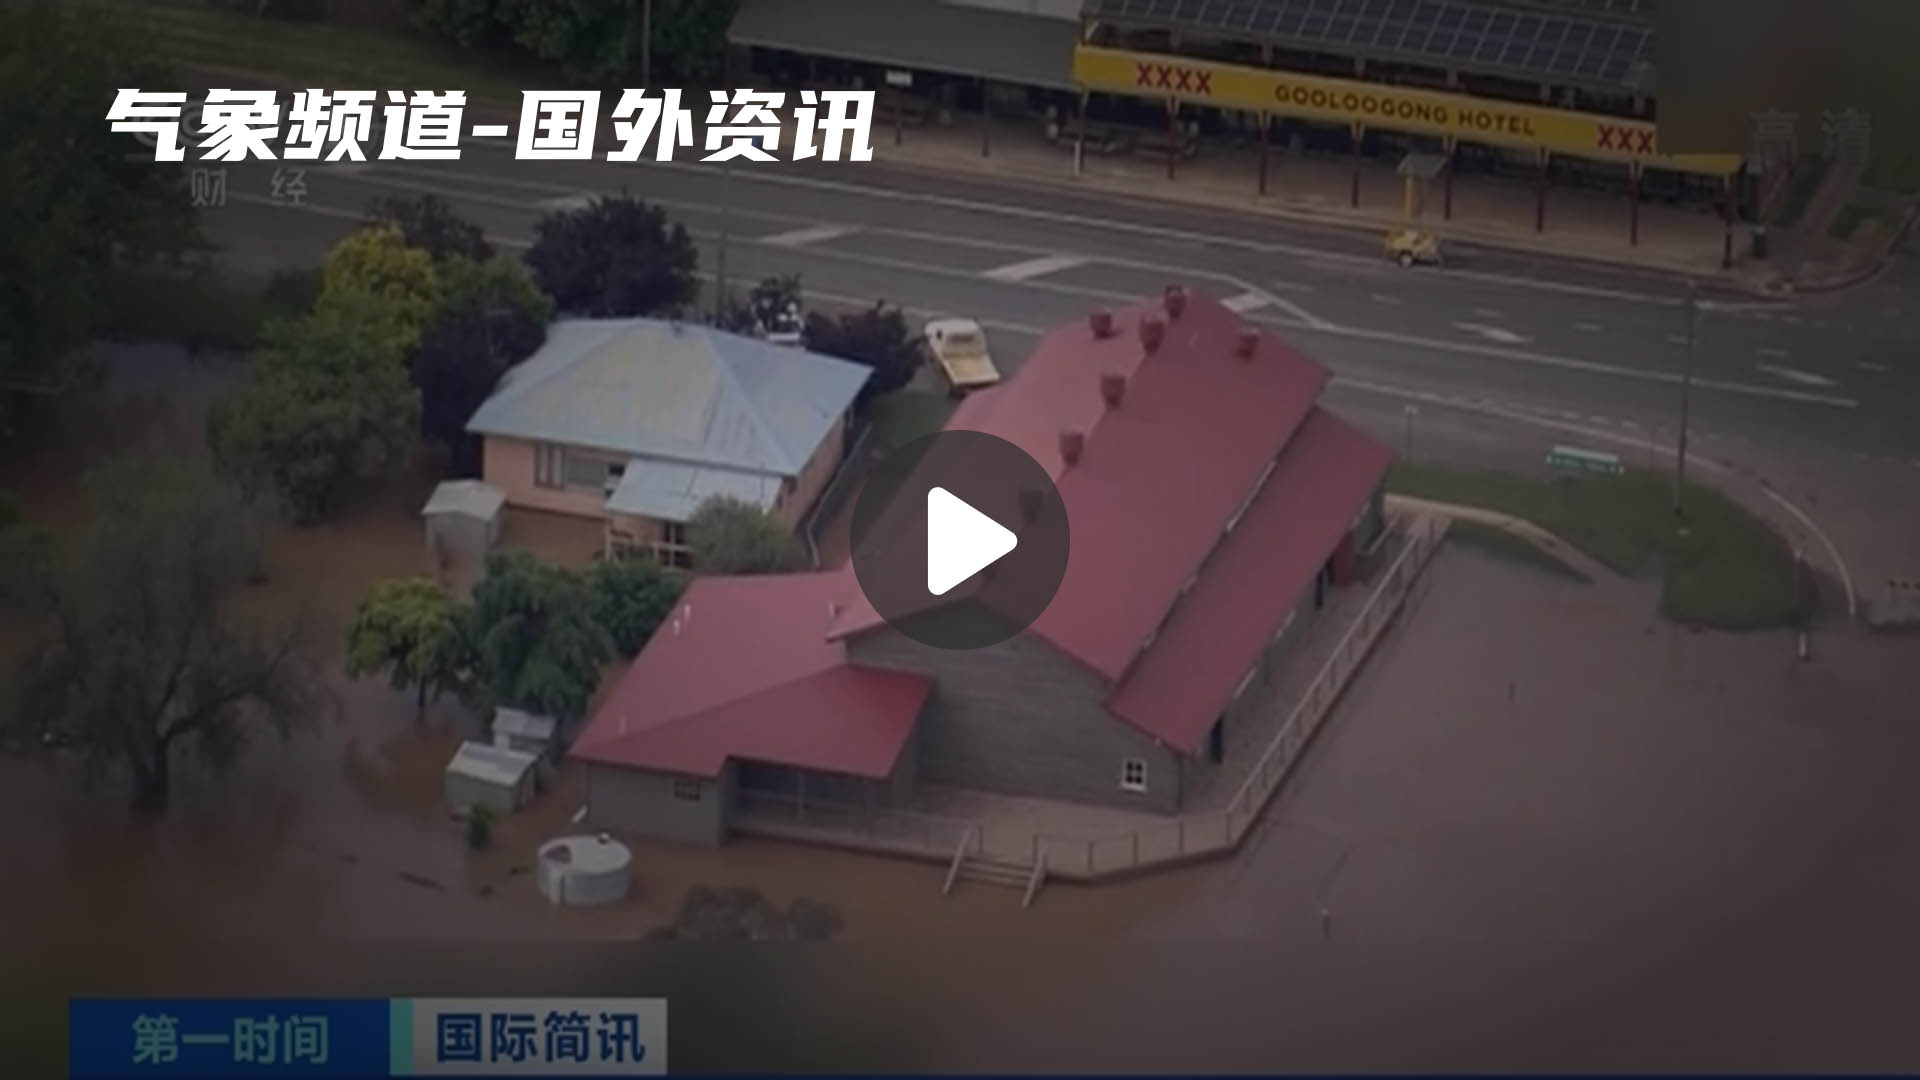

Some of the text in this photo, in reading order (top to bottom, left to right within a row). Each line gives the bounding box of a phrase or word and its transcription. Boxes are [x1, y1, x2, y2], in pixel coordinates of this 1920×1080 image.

[1136, 64, 1212, 94] XXXX
[1275, 84, 1535, 136] GOOLOOGONG HOTEL
